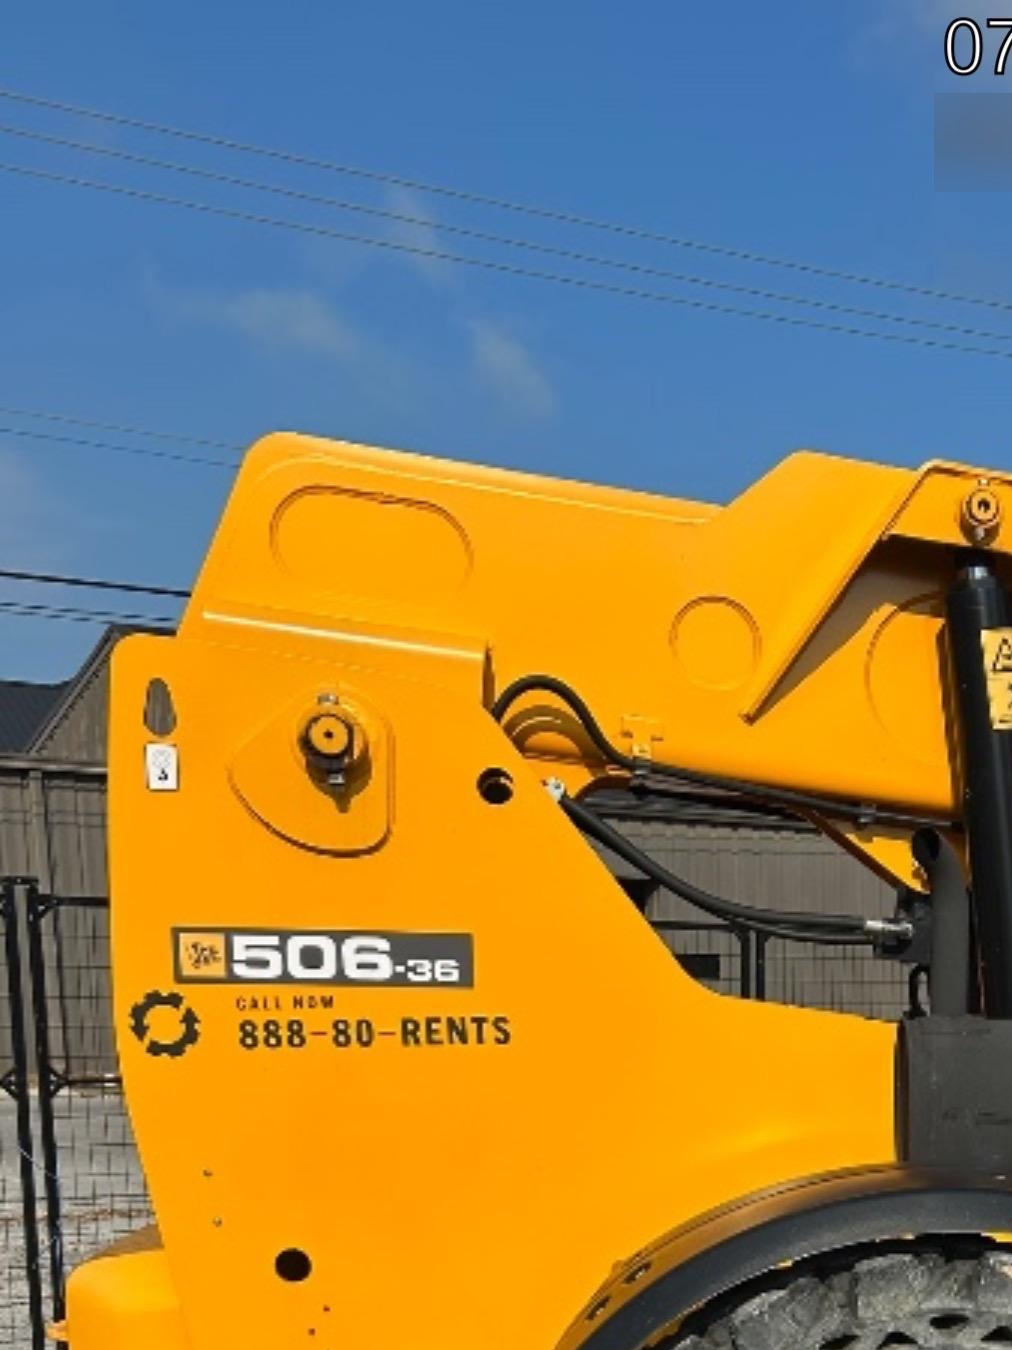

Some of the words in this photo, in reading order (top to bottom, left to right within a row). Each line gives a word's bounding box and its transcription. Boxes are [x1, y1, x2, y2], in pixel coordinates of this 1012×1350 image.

[231, 934, 461, 982] 506-36
[236, 996, 282, 1011] CALL
[293, 995, 335, 1010] NOW
[238, 1016, 511, 1049] 888-80-RENTS
